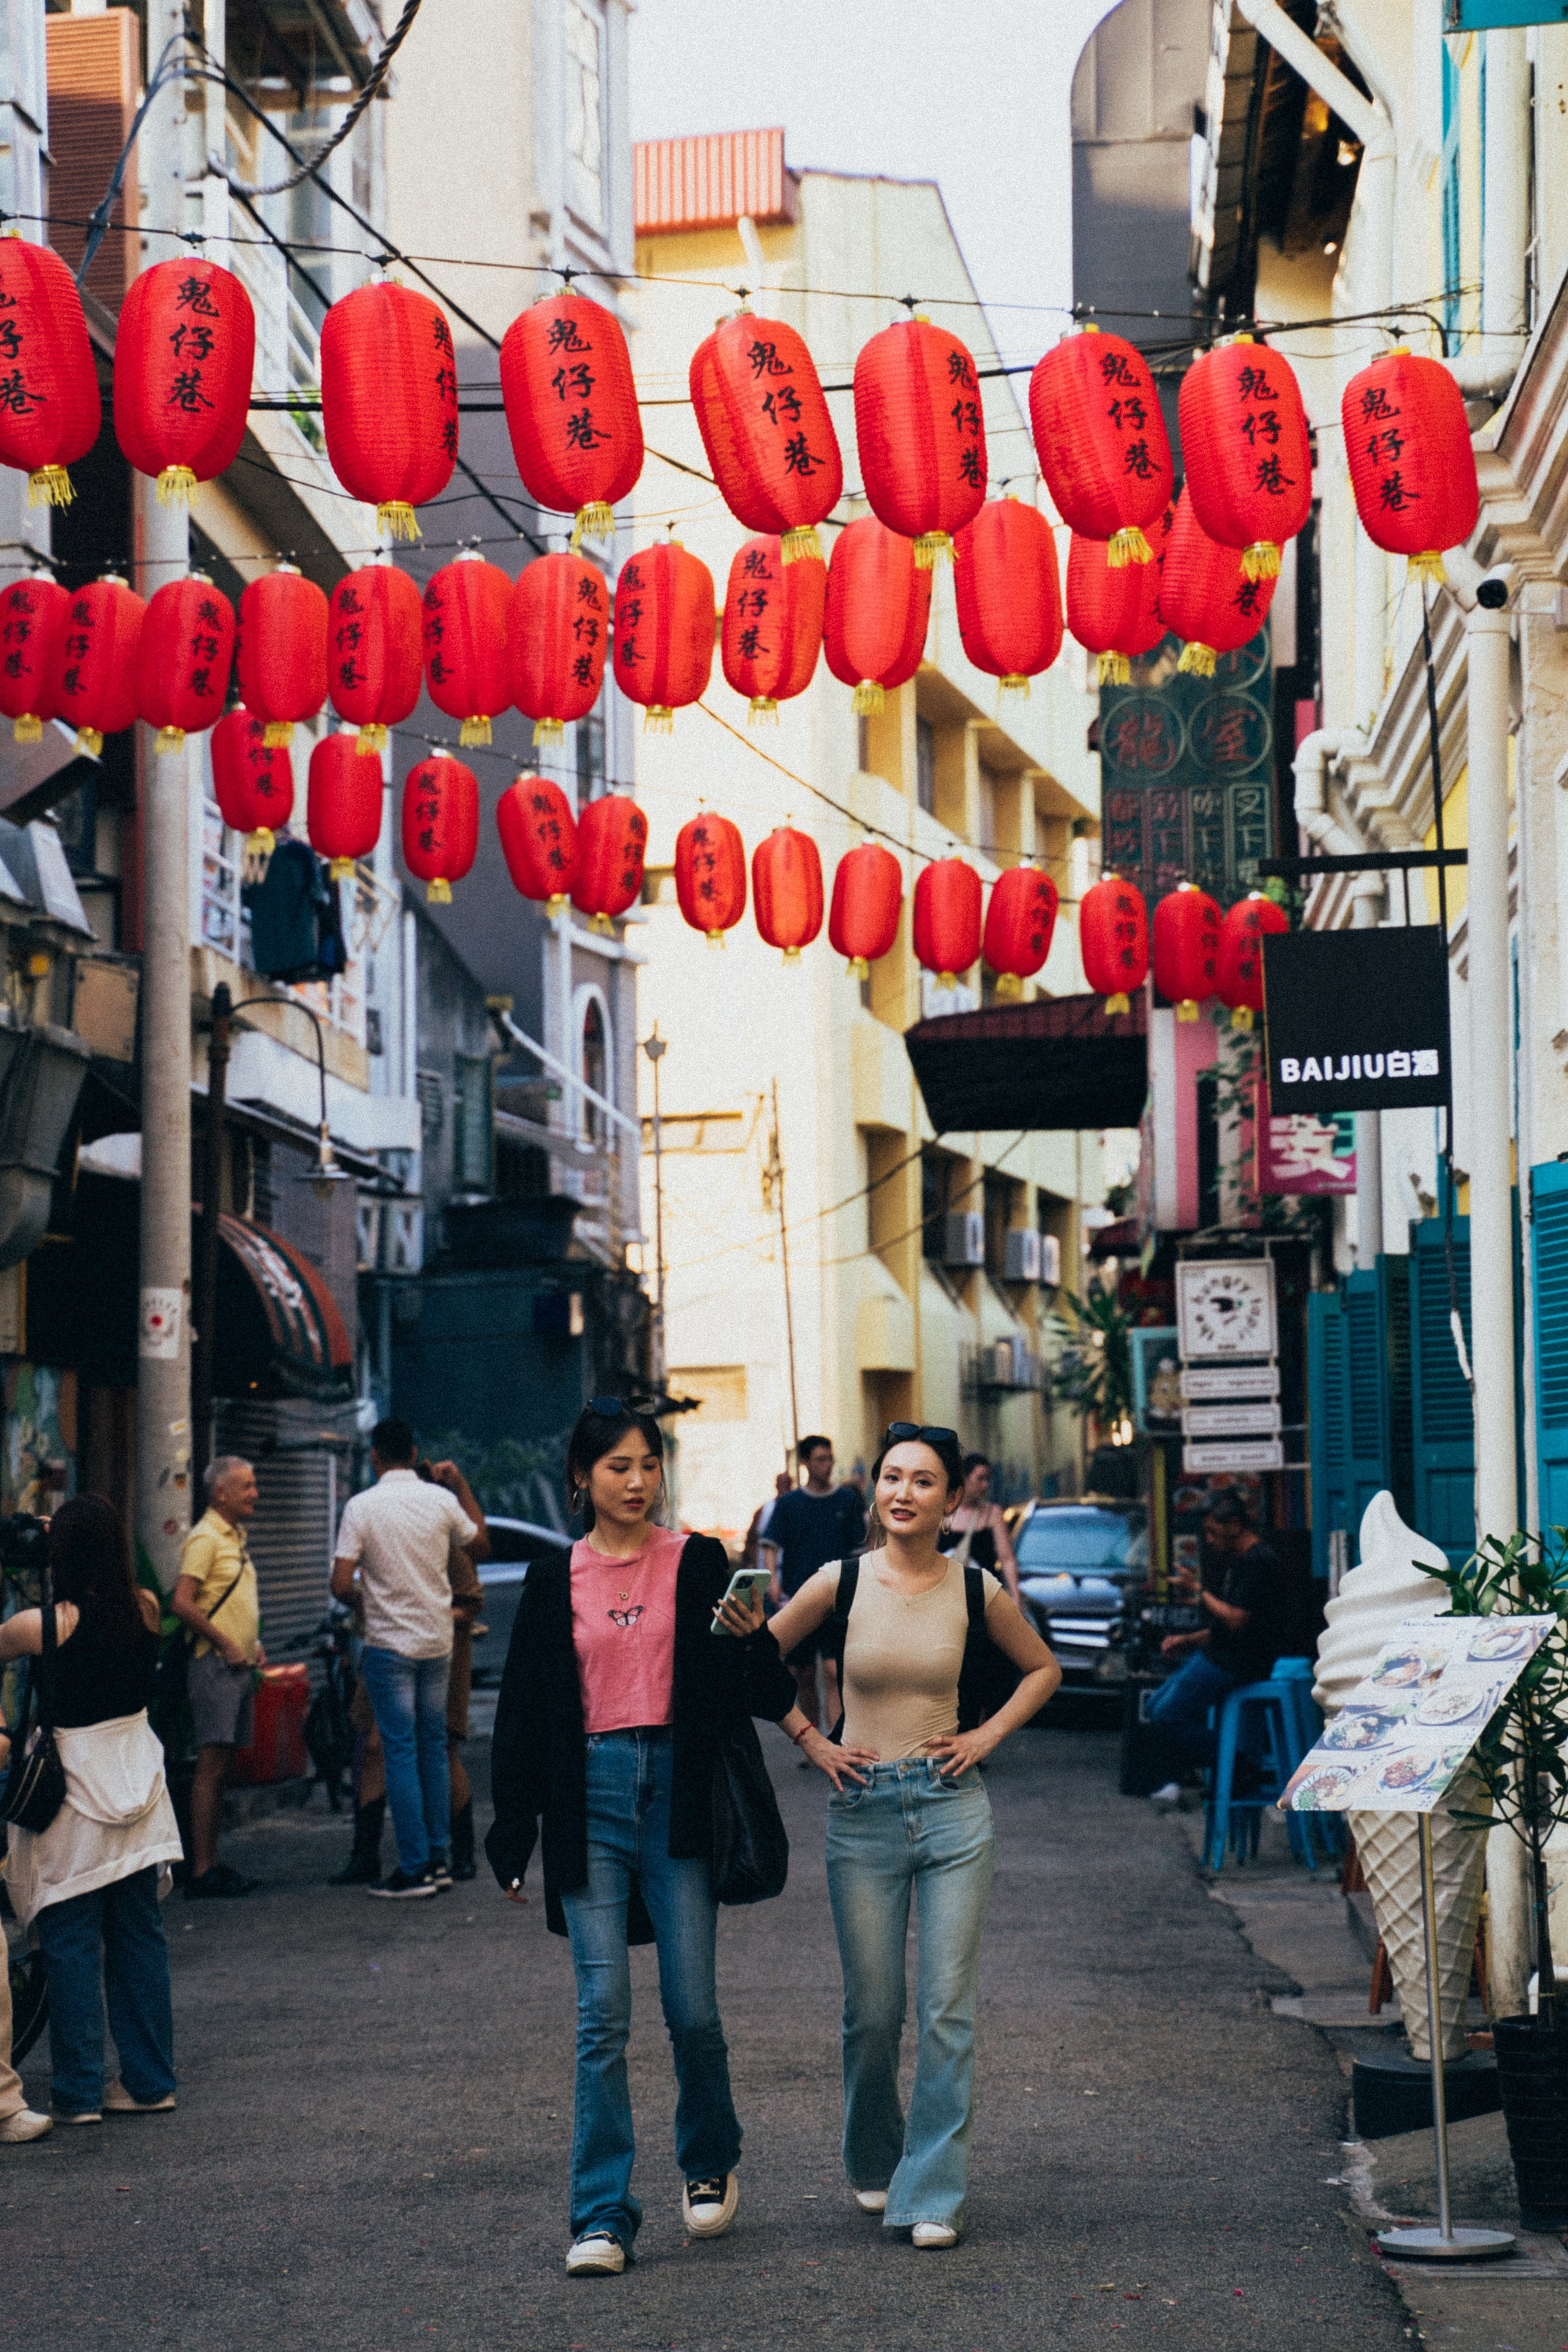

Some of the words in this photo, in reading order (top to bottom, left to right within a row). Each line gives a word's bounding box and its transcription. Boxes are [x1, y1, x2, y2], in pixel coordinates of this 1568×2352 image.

[169, 276, 219, 413] 鬼仔巷
[547, 318, 612, 450] 鬼仔巷
[747, 341, 826, 476] 鬼仔巷
[948, 350, 986, 489] 鬼仔巷
[1099, 351, 1161, 480] 鬼仔巷
[1238, 366, 1295, 496] 鬼仔巷
[1360, 388, 1420, 512] 鬼仔巷
[573, 576, 603, 688] 鬼仔巷
[737, 549, 772, 660] 鬼仔巷
